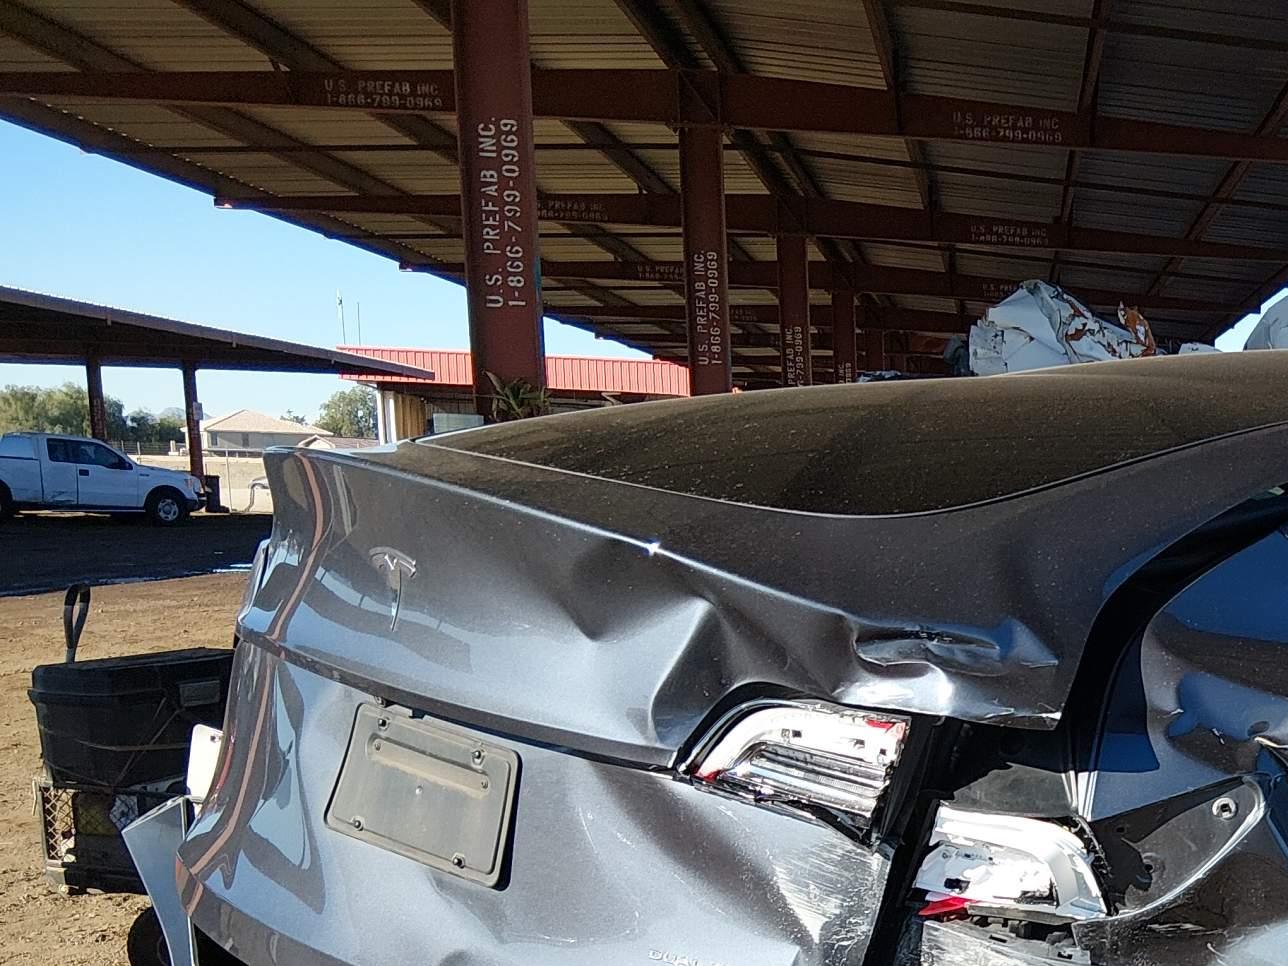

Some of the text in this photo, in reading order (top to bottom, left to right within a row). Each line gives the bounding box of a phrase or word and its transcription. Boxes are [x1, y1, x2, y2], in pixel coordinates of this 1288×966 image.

[358, 80, 411, 95] PREFAB
[984, 113, 1033, 128] PREFAB
[478, 117, 504, 308] U.S. PREFAB INC.
[500, 119, 526, 306] 1-866-799-0969
[694, 250, 710, 365] U.S. PREFAB INC.
[707, 251, 722, 364] 1-866-799-0969
